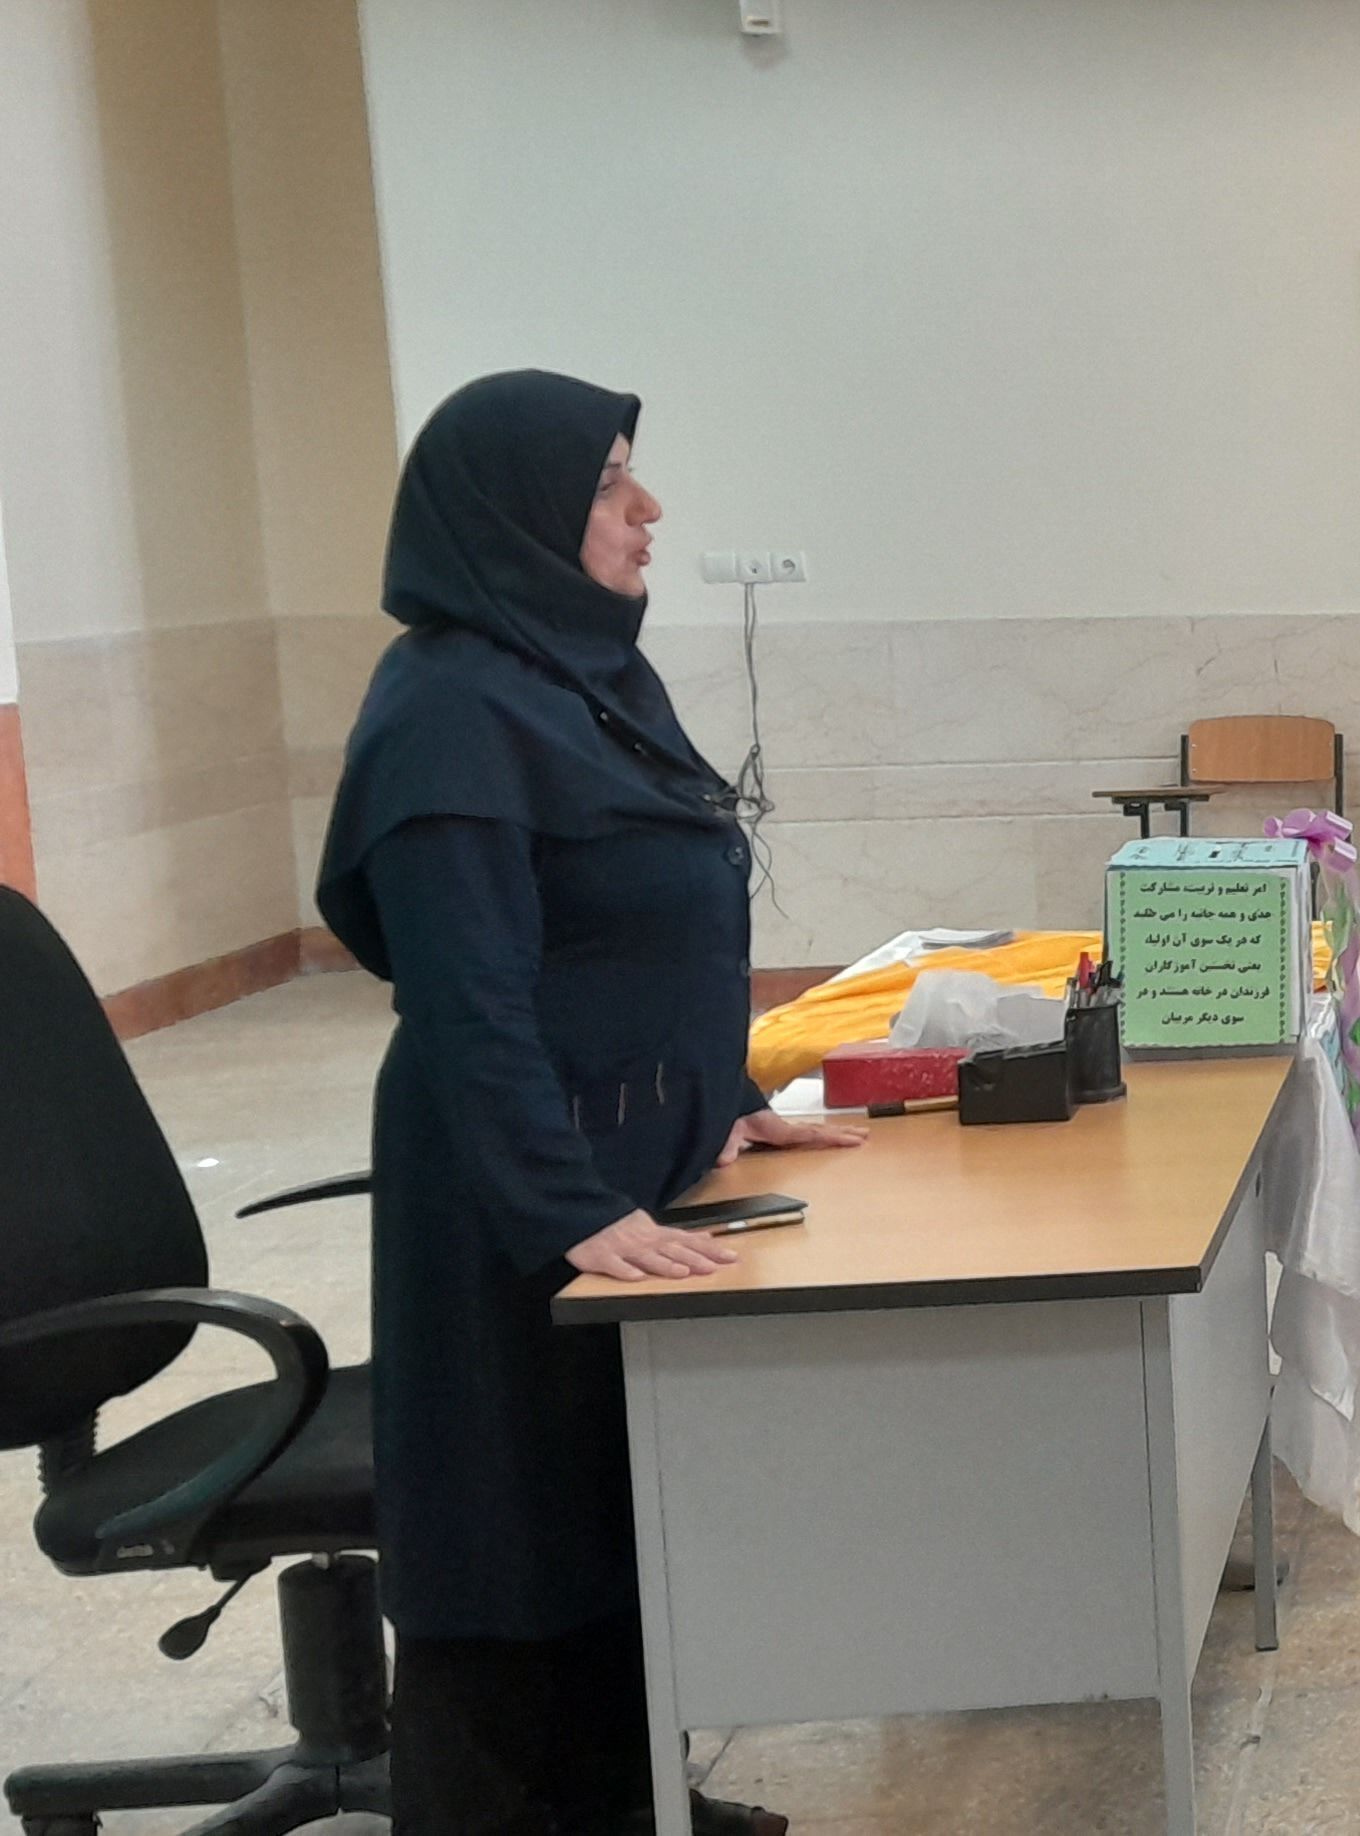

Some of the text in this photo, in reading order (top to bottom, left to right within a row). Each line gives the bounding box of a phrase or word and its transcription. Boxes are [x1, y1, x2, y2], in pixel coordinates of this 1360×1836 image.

[1217, 886, 1224, 896] و
[1225, 882, 1250, 895] تعلیم
[1252, 883, 1267, 897] امر
[1177, 908, 1188, 922] را
[1217, 911, 1237, 919] همه
[1239, 912, 1246, 922] و
[1172, 932, 1187, 948] آن
[1189, 938, 1214, 948] سوی
[1215, 934, 1233, 946] یک
[1234, 936, 1248, 948] در
[1249, 934, 1262, 945] که
[1237, 962, 1262, 974] یعنی
[1135, 987, 1149, 1000] در
[1150, 989, 1158, 1000] و
[1191, 985, 1213, 997] خانه
[1215, 987, 1229, 1000] در
[1220, 1014, 1246, 1026] سوی
